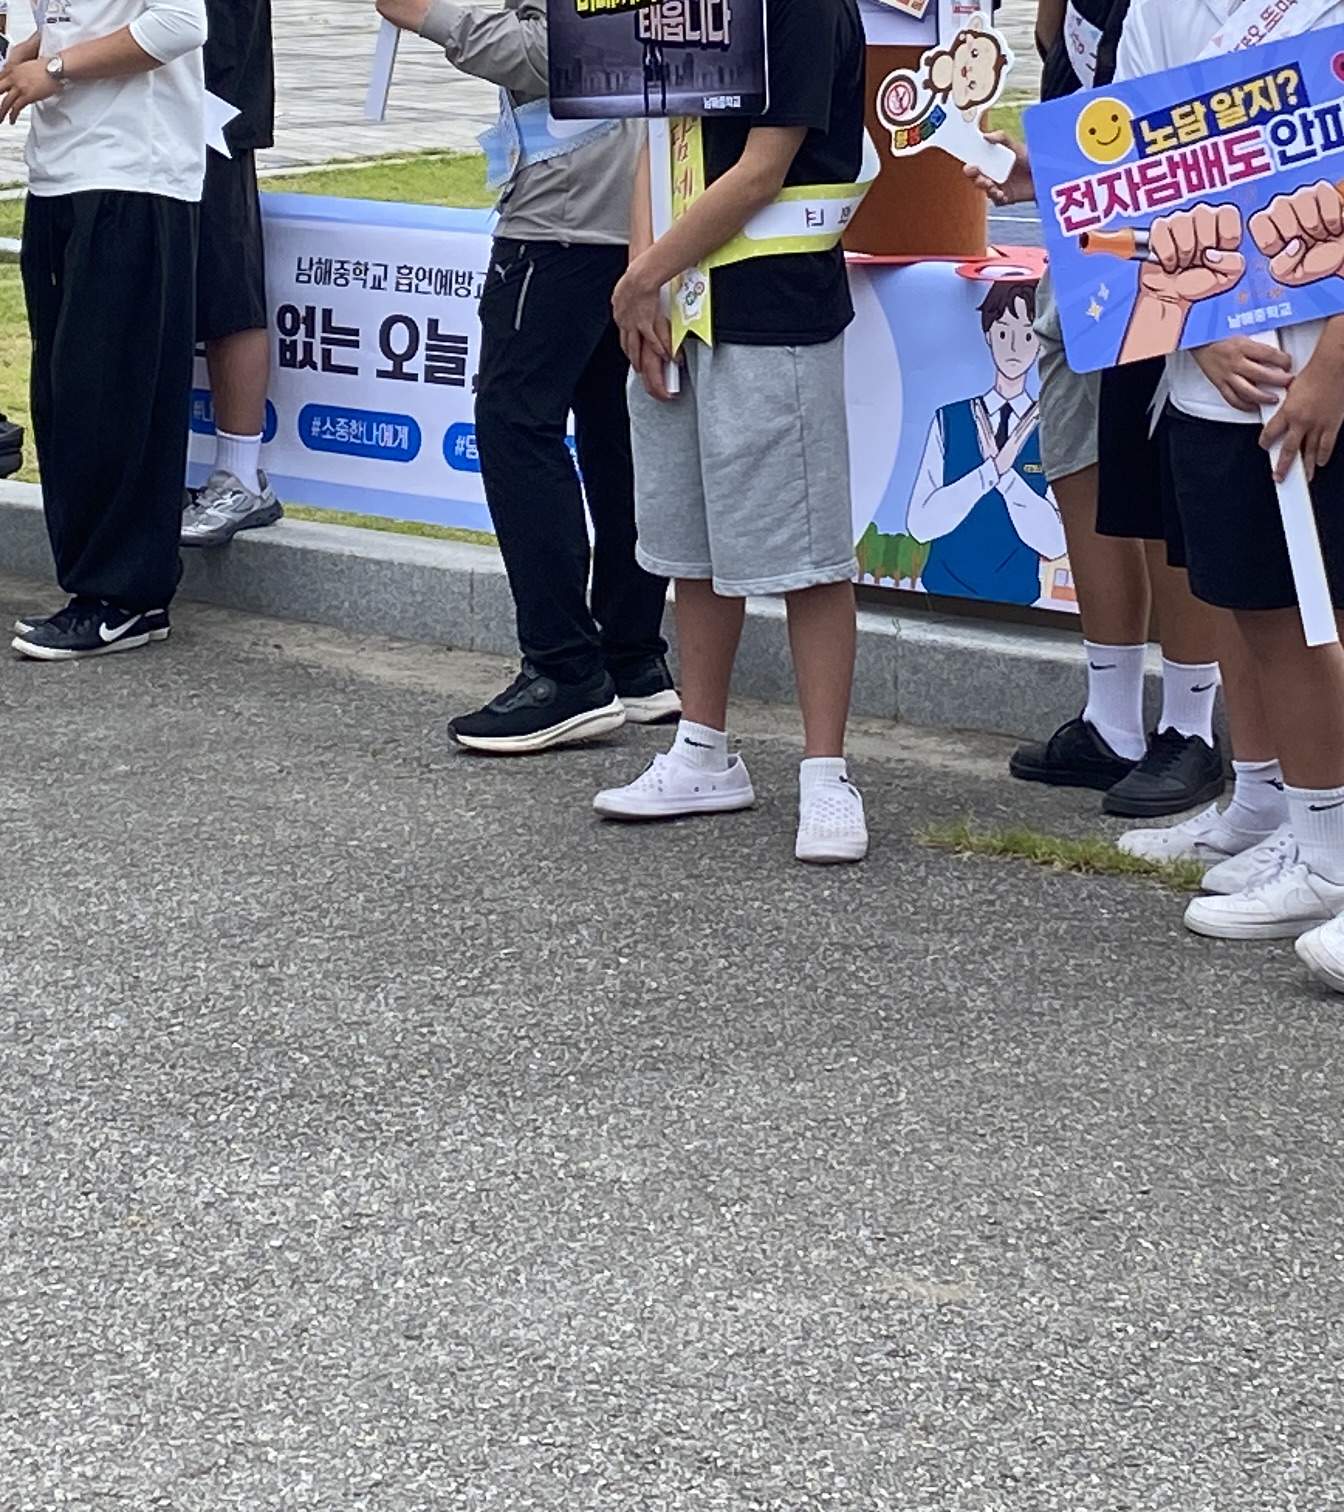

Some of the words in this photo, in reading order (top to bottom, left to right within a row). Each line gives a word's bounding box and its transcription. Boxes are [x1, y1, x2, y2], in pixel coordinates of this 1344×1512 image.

[1138, 105, 1208, 154] 노담
[1209, 69, 1300, 131] 알지?
[1054, 130, 1272, 233] 전자담배도
[295, 256, 389, 291] 남해중학교
[276, 303, 361, 377] 없는
[1226, 301, 1294, 329] 남해중학교
[310, 415, 409, 451] #소중한나에게
